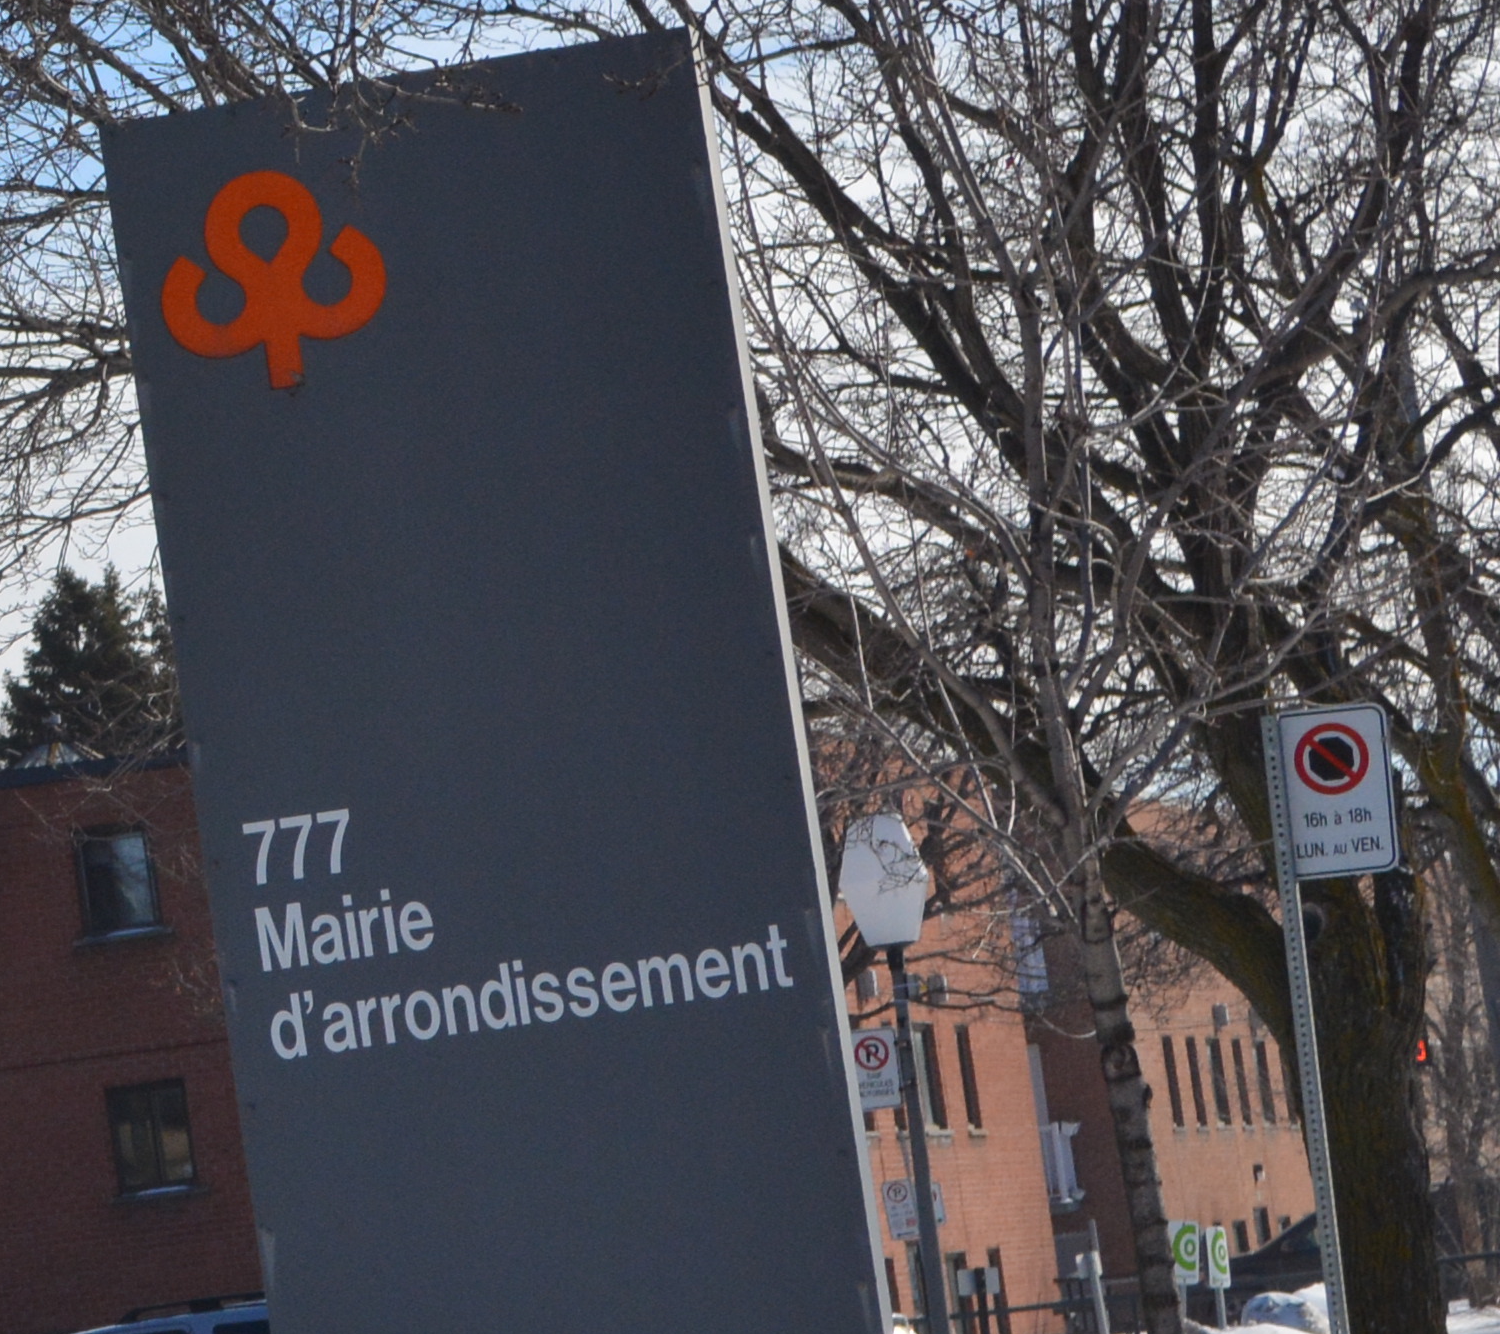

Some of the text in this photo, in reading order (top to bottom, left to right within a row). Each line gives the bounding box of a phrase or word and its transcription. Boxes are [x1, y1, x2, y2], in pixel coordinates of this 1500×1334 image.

[242, 809, 350, 885] 777
[1296, 835, 1385, 859] LUN. AU VEN.
[1304, 811, 1328, 828] 16h
[1348, 807, 1373, 823] 18h
[254, 889, 434, 972] Mairie
[270, 924, 794, 1060] d'arrondissement
